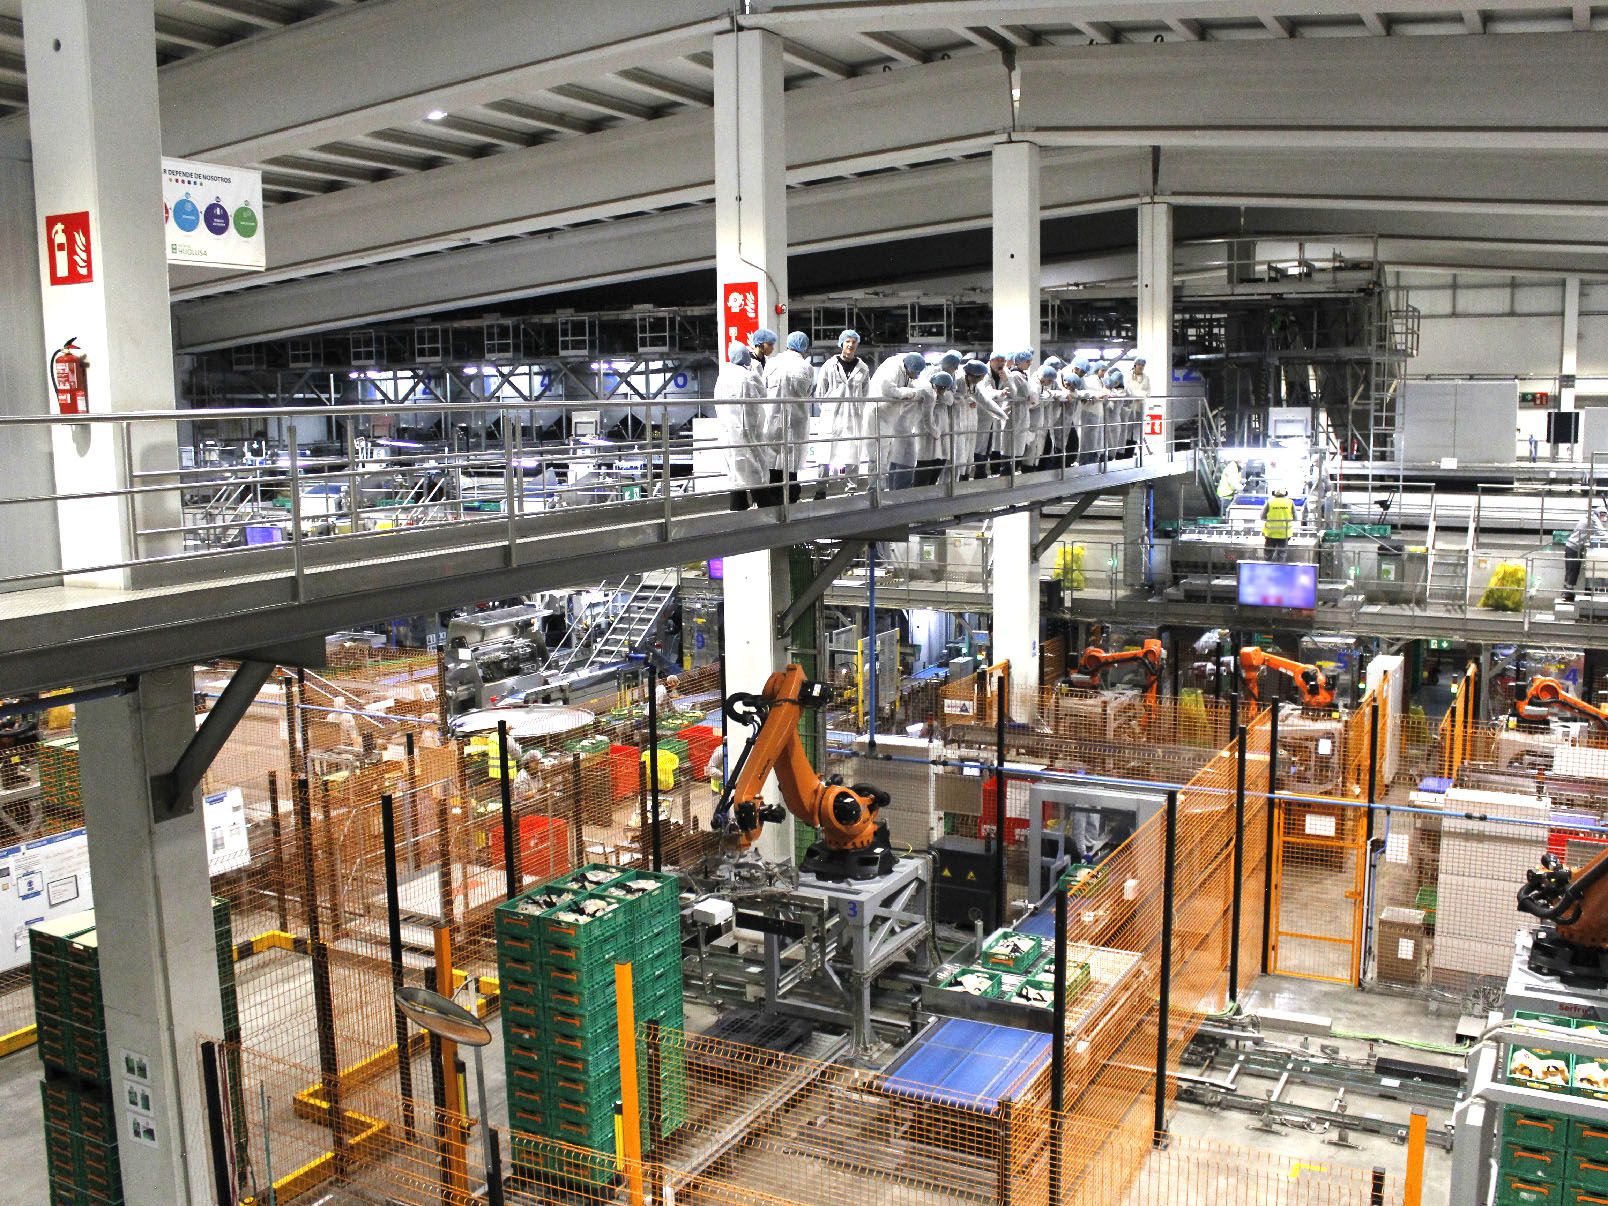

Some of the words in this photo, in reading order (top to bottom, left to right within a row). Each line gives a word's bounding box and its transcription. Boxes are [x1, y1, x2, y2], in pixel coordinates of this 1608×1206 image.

[168, 169, 194, 179] DEPENDE
[194, 172, 202, 180] DE
[202, 173, 232, 184] NOSOTROS
[1564, 667, 1578, 687] 4
[847, 900, 858, 917] 3
